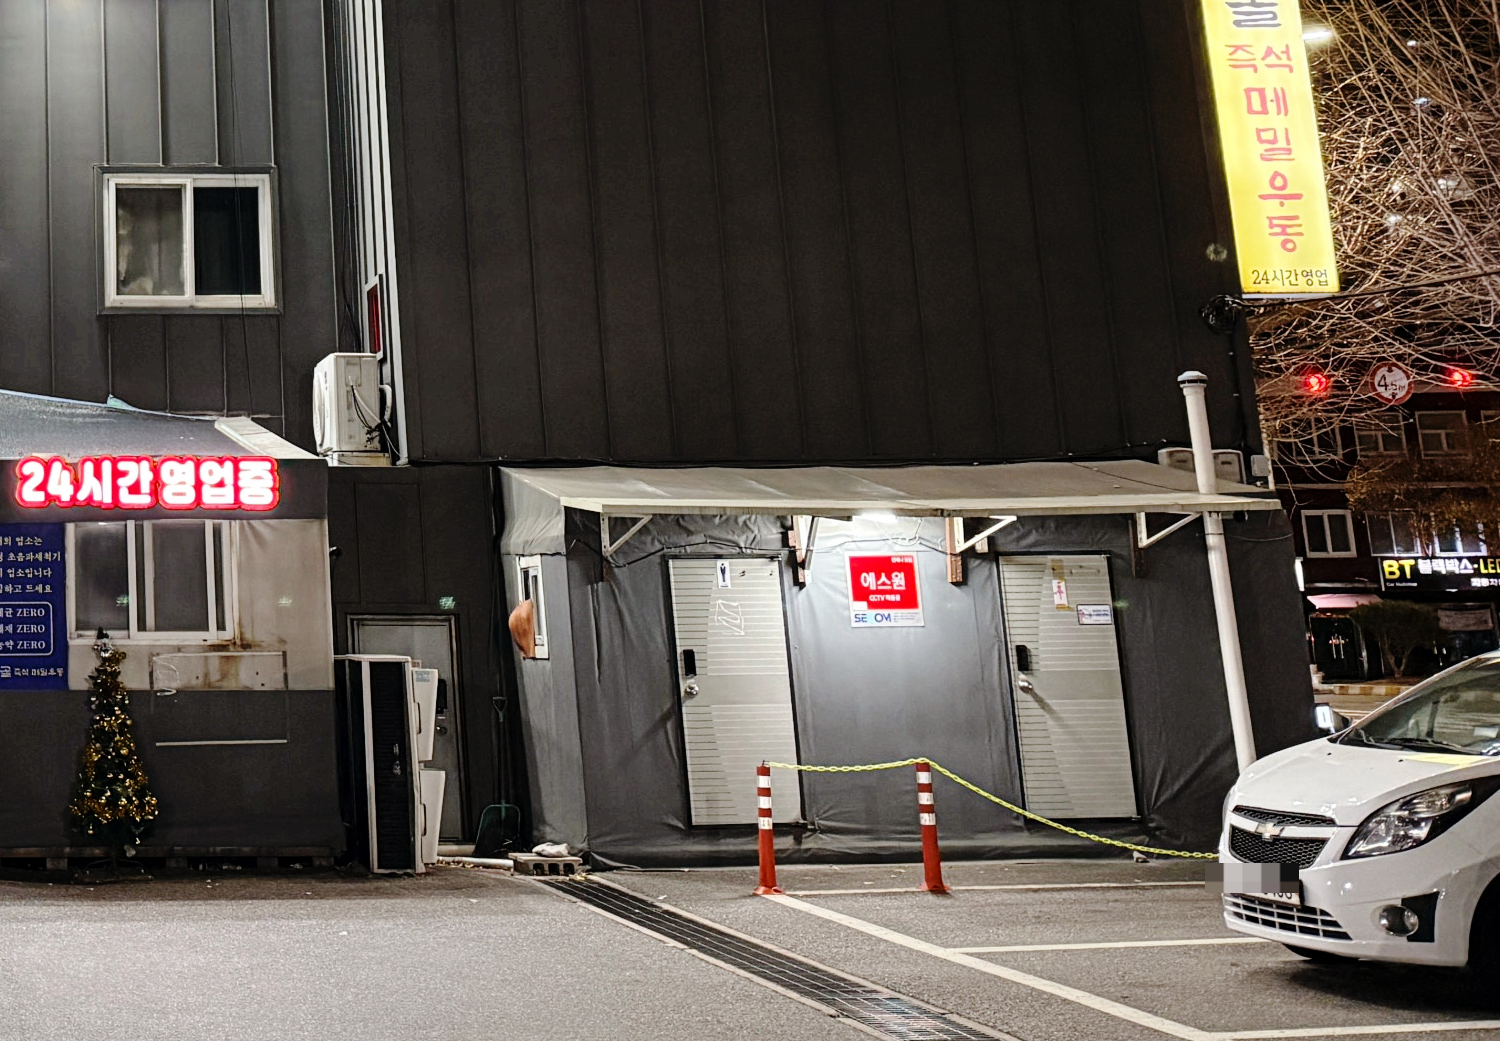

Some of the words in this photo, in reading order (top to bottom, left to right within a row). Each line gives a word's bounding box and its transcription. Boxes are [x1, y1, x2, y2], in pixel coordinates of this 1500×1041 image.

[1225, 43, 1294, 74] 즉석
[1243, 86, 1305, 253] 메밀우동
[15, 536, 43, 546] 업소는
[6, 567, 52, 578] 업소입니다
[1383, 559, 1416, 579] BT
[860, 571, 906, 591] 에스원
[25, 583, 53, 594] 드세요
[16, 607, 46, 617] ZERO
[16, 624, 46, 633] ZERO
[16, 640, 47, 650] ZERO
